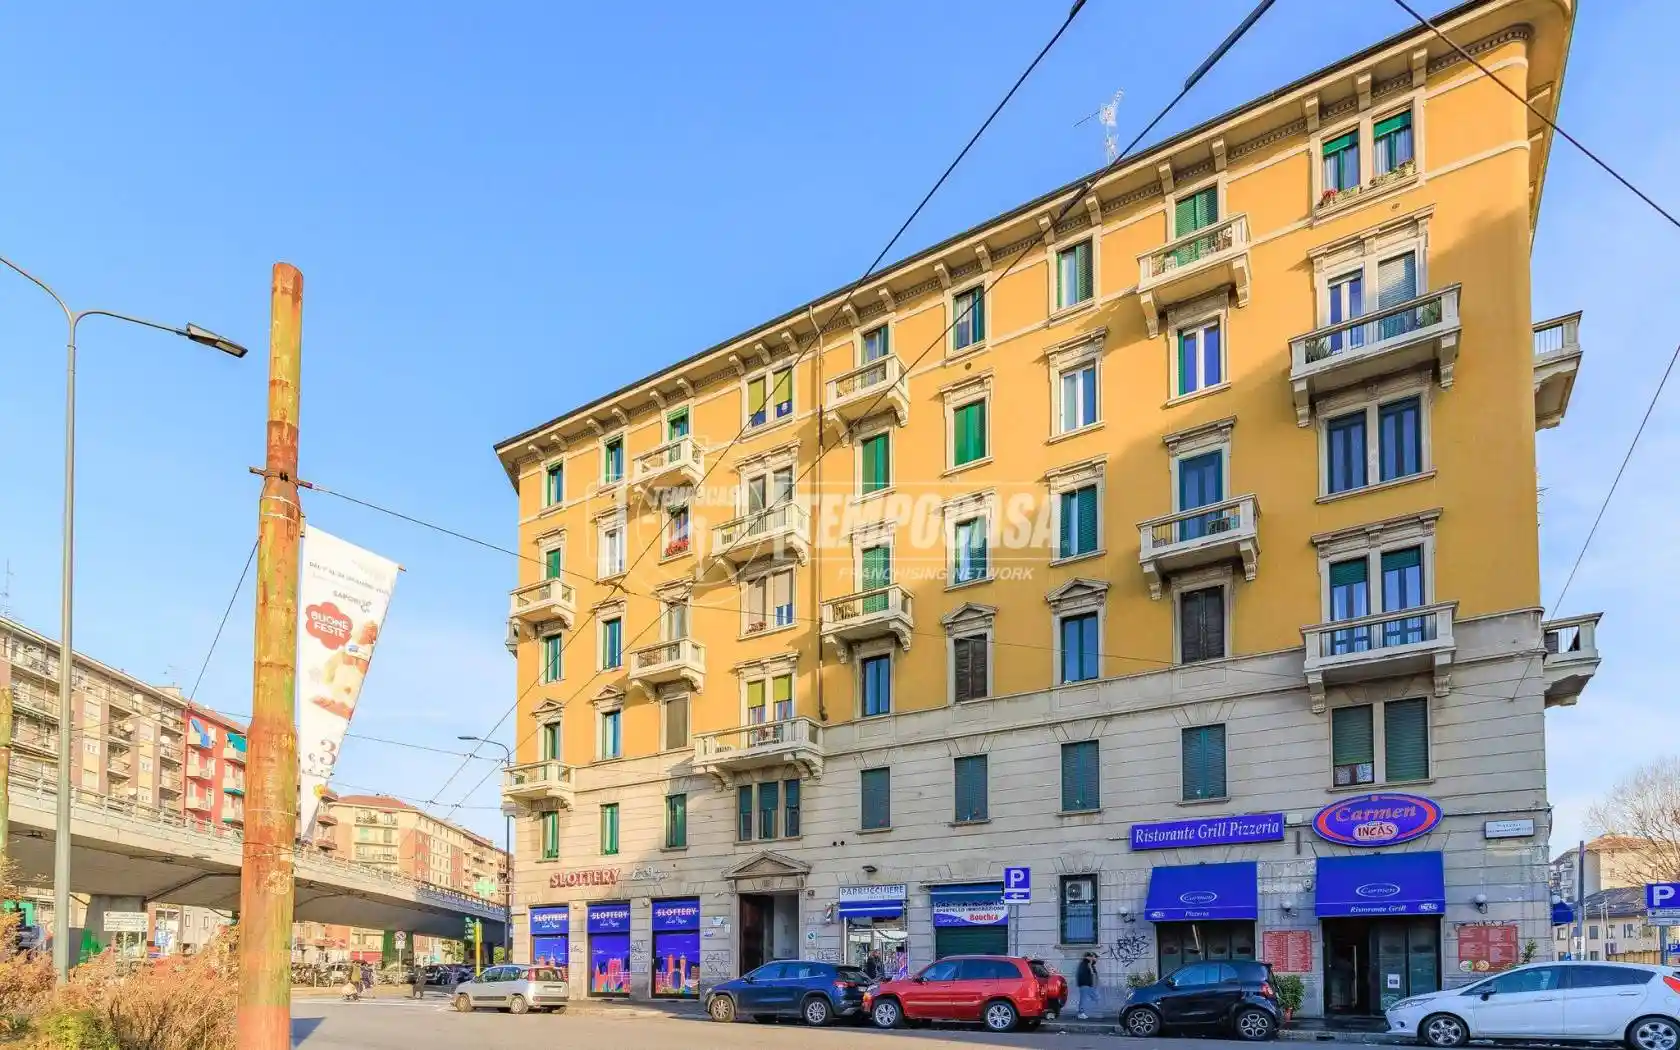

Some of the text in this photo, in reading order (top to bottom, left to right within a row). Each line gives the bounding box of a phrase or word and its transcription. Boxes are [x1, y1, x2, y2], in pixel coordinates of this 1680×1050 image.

[310, 610, 350, 631] BUONE
[314, 621, 346, 638] FESTE
[1335, 805, 1417, 822] Carmen
[1135, 818, 1280, 844] Ristorante Grill Pizzeria
[1357, 826, 1393, 837] INCAS
[550, 867, 621, 889] SLOTTERY
[1010, 869, 1025, 888] P
[841, 885, 904, 896] PARRUCCHIERE
[1360, 886, 1396, 894] Carmen
[1653, 885, 1676, 906] P
[534, 913, 568, 922] SLOTTERY
[591, 911, 629, 920] SLOTTERY
[656, 907, 697, 917] SLOTTERY
[969, 913, 998, 921] Bouchra
